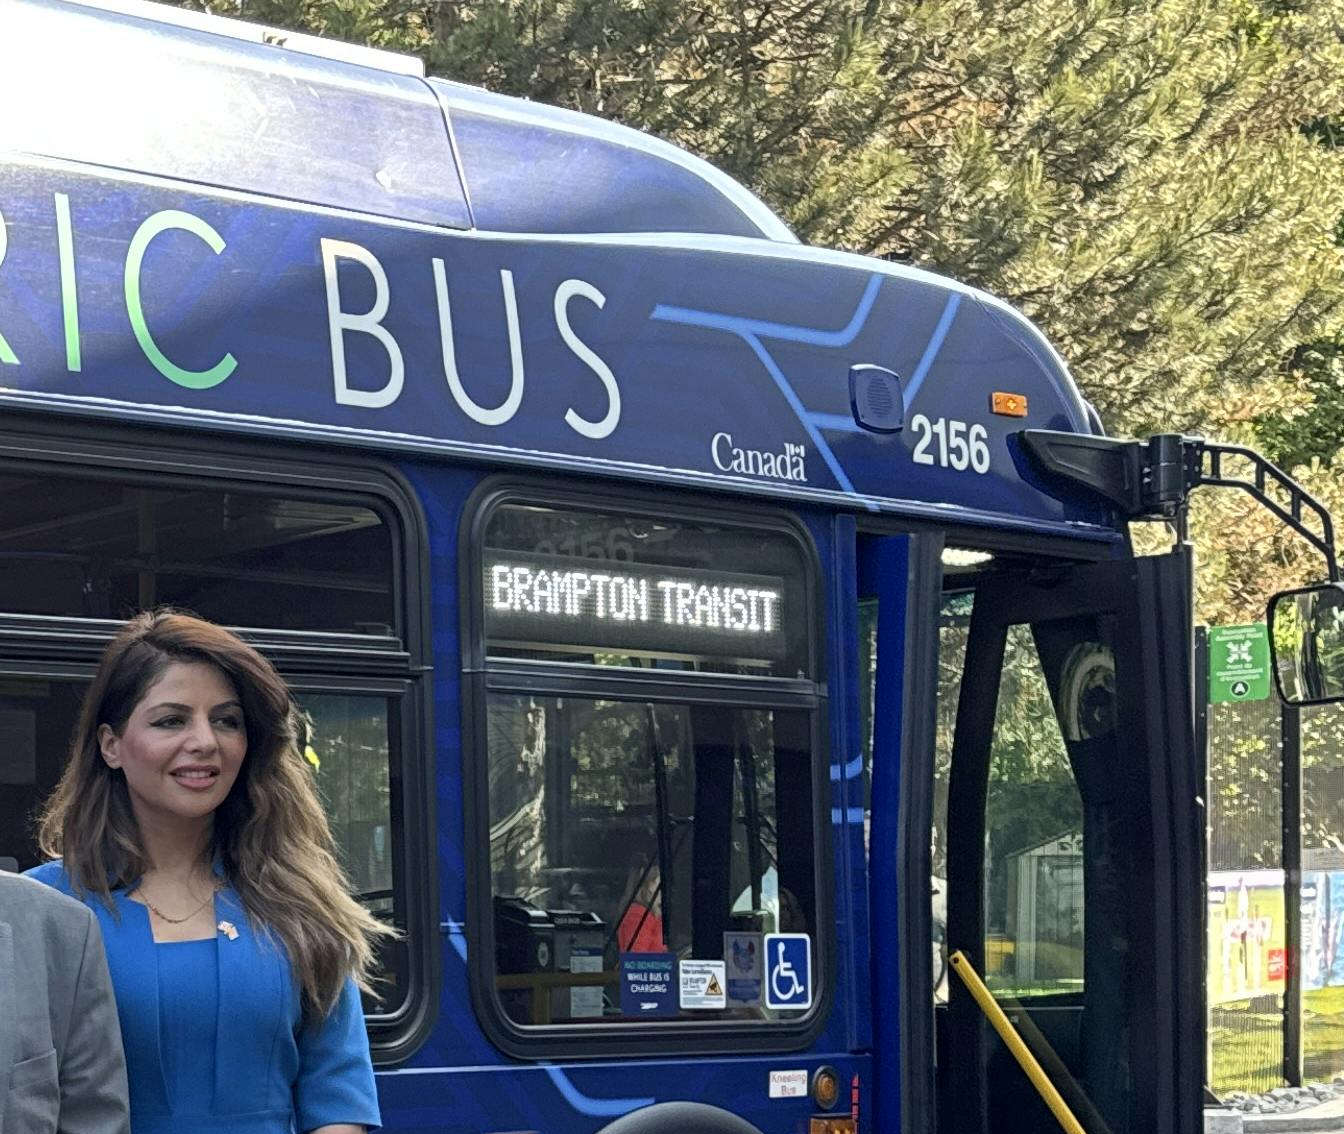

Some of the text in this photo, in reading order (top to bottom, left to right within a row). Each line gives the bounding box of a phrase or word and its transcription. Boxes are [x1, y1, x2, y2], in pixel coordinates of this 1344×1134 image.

[320, 237, 622, 440] BUS
[911, 413, 990, 475] 2156
[711, 432, 808, 482] Canada
[490, 564, 778, 632] BRAMPTON TRANSIT
[1234, 682, 1246, 694] A
[627, 972, 670, 982] WHILE BUS IS
[630, 983, 667, 993] CHARGING
[772, 1073, 807, 1085] Kneeling
[781, 1085, 797, 1096] Bus
